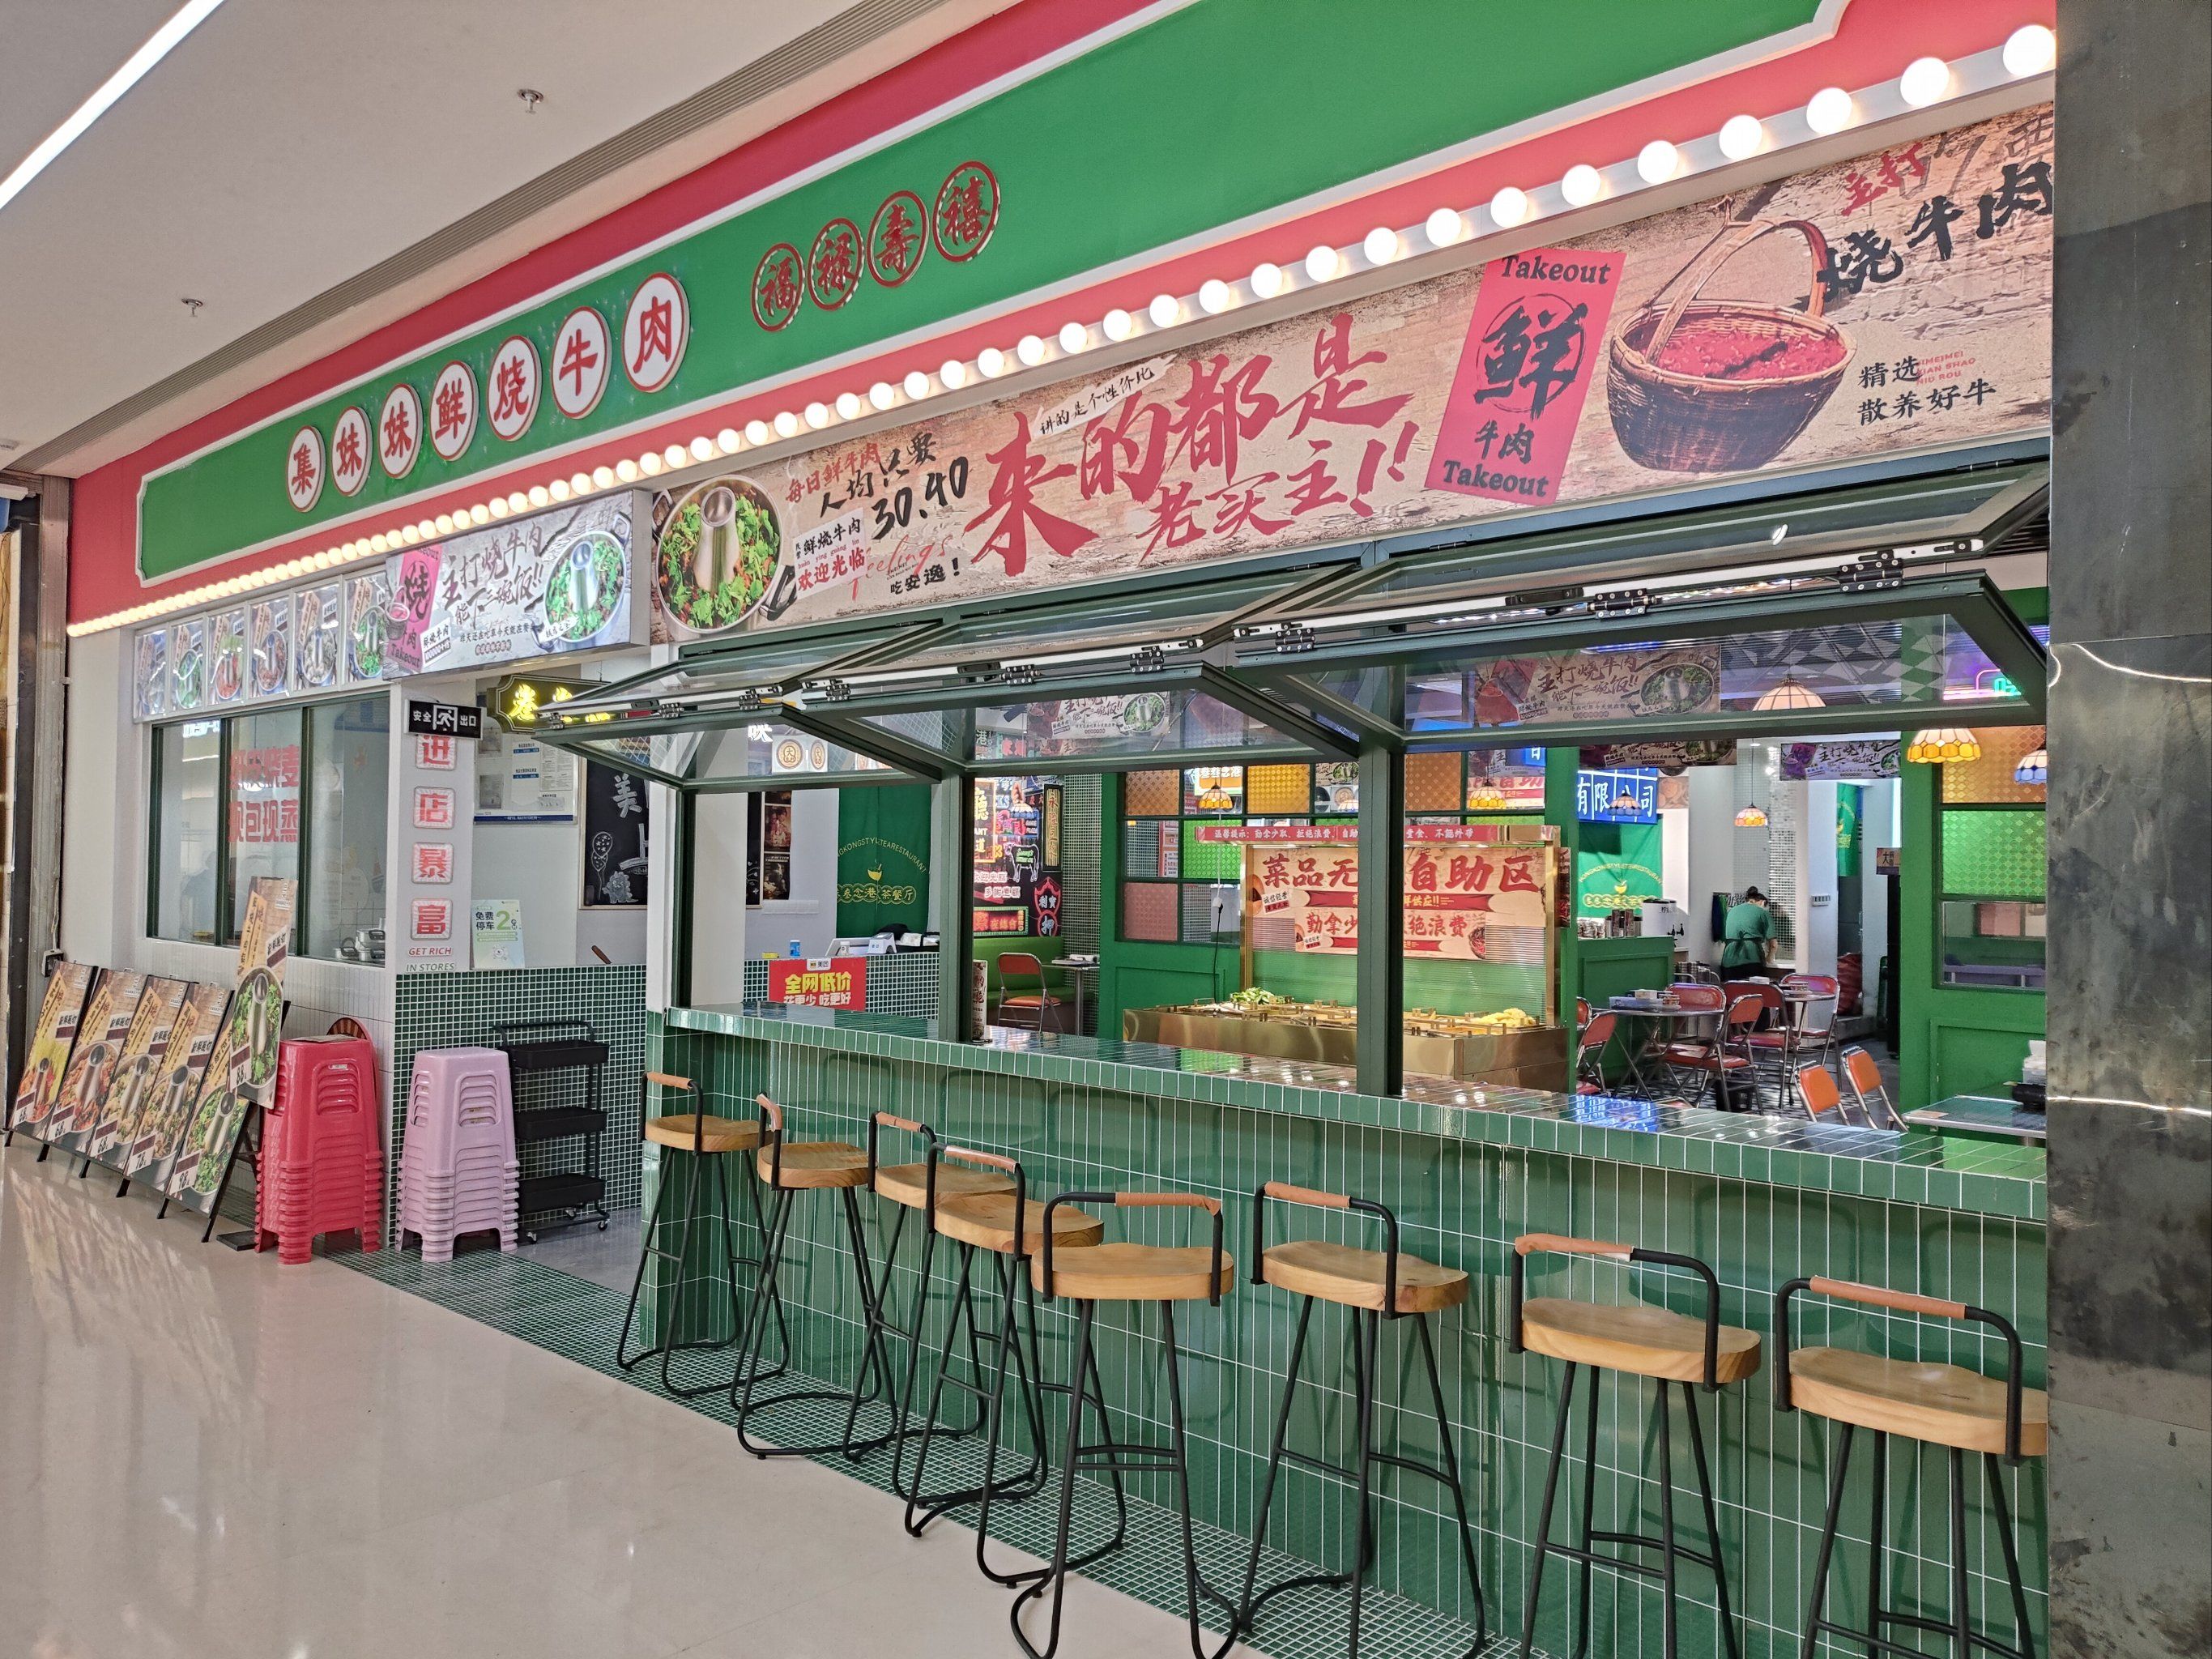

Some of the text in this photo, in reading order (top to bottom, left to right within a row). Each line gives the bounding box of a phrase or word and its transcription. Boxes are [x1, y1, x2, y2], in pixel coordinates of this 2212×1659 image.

[1817, 161, 2054, 302] 烧牛肉
[1502, 254, 1611, 284] Takeout
[1473, 303, 1588, 421] 鲜
[1858, 356, 1923, 389] 精选
[1938, 370, 1962, 380] ROU
[1946, 357, 1976, 369] SHAO
[292, 295, 672, 496] 集妹妹鲜烧牛肉
[1040, 367, 1155, 435] 讲的是个性价比
[1857, 378, 1997, 426] 散养好牛
[964, 313, 1415, 577] 来的都是
[1475, 420, 1534, 464] 牛肉
[786, 442, 880, 504] 每日鲜牛肉
[820, 432, 936, 518] 人均只要
[1443, 460, 1549, 497] Takeout
[803, 518, 860, 555] 鲜烧牛肉
[442, 523, 543, 609] 主打烧牛肉
[798, 547, 865, 591] 欢迎光临
[413, 710, 476, 727] 安全 出口
[613, 773, 642, 818] 美
[416, 735, 451, 936] 进店暴富
[1262, 853, 1358, 889] 菜品无
[1410, 851, 1541, 892] 自助区
[475, 911, 494, 921] 免费
[476, 921, 495, 931] 停车
[496, 911, 512, 931] 2
[1404, 915, 1468, 937] 绝浪费
[406, 962, 454, 973] IN STORES
[408, 945, 452, 956] GET RICH
[785, 971, 852, 995] 全网低价
[819, 992, 851, 1006] 吃更好
